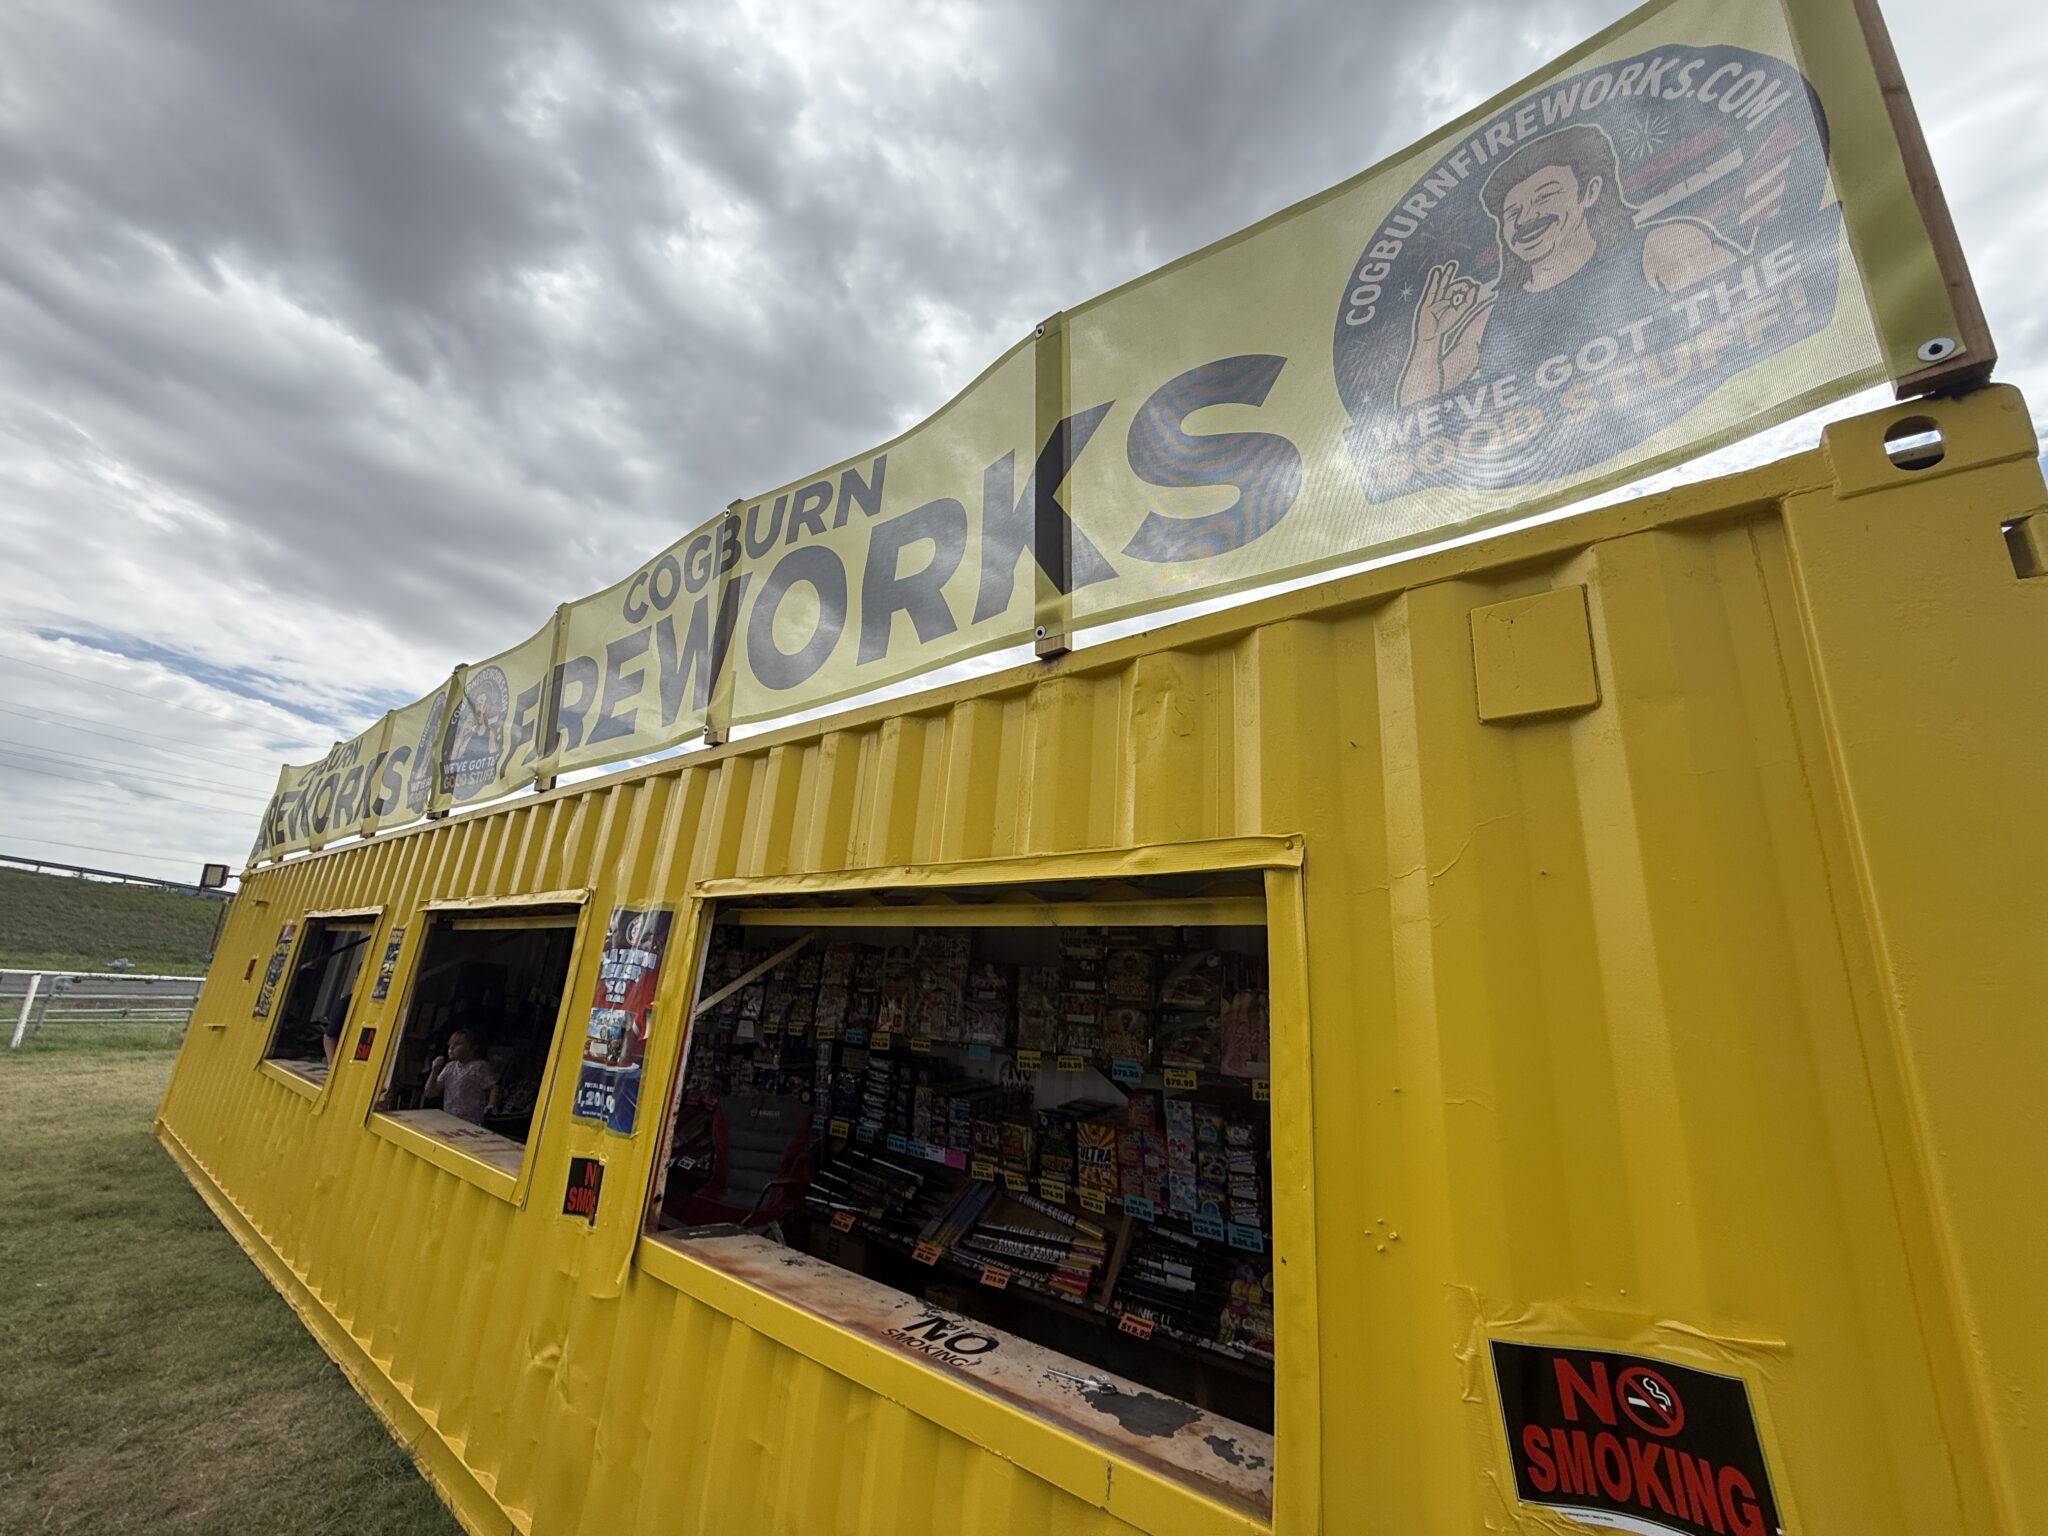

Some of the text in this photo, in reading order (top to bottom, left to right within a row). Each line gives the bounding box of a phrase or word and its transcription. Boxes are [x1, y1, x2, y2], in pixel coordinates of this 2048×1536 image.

[1345, 57, 1791, 326] COGBURNFIREWORKS.COM
[1374, 241, 1802, 448] WE'VE GOT THE
[622, 455, 888, 625] COGBURN
[1079, 1145, 1113, 1163] ULTRA
[902, 1317, 1000, 1355] NO
[1522, 1424, 1766, 1536] SMOKING
